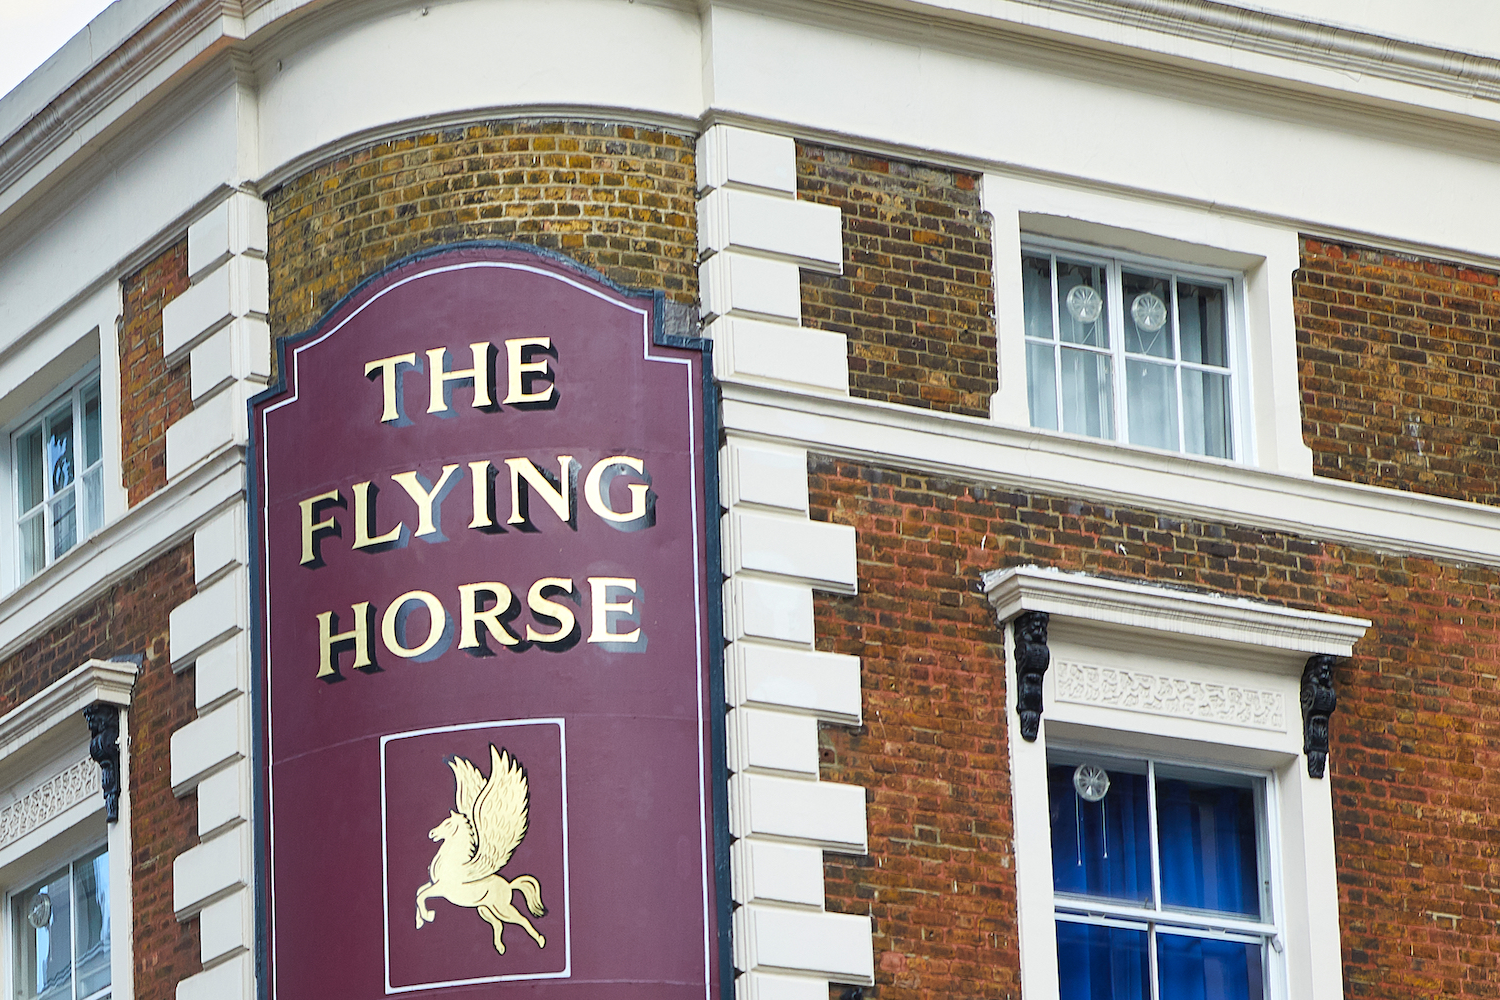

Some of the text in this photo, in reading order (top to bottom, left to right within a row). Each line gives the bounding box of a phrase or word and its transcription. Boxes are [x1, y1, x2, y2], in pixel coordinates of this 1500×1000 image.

[364, 336, 558, 426] THE
[298, 454, 654, 568] FLYING
[315, 576, 645, 681] HORSE
